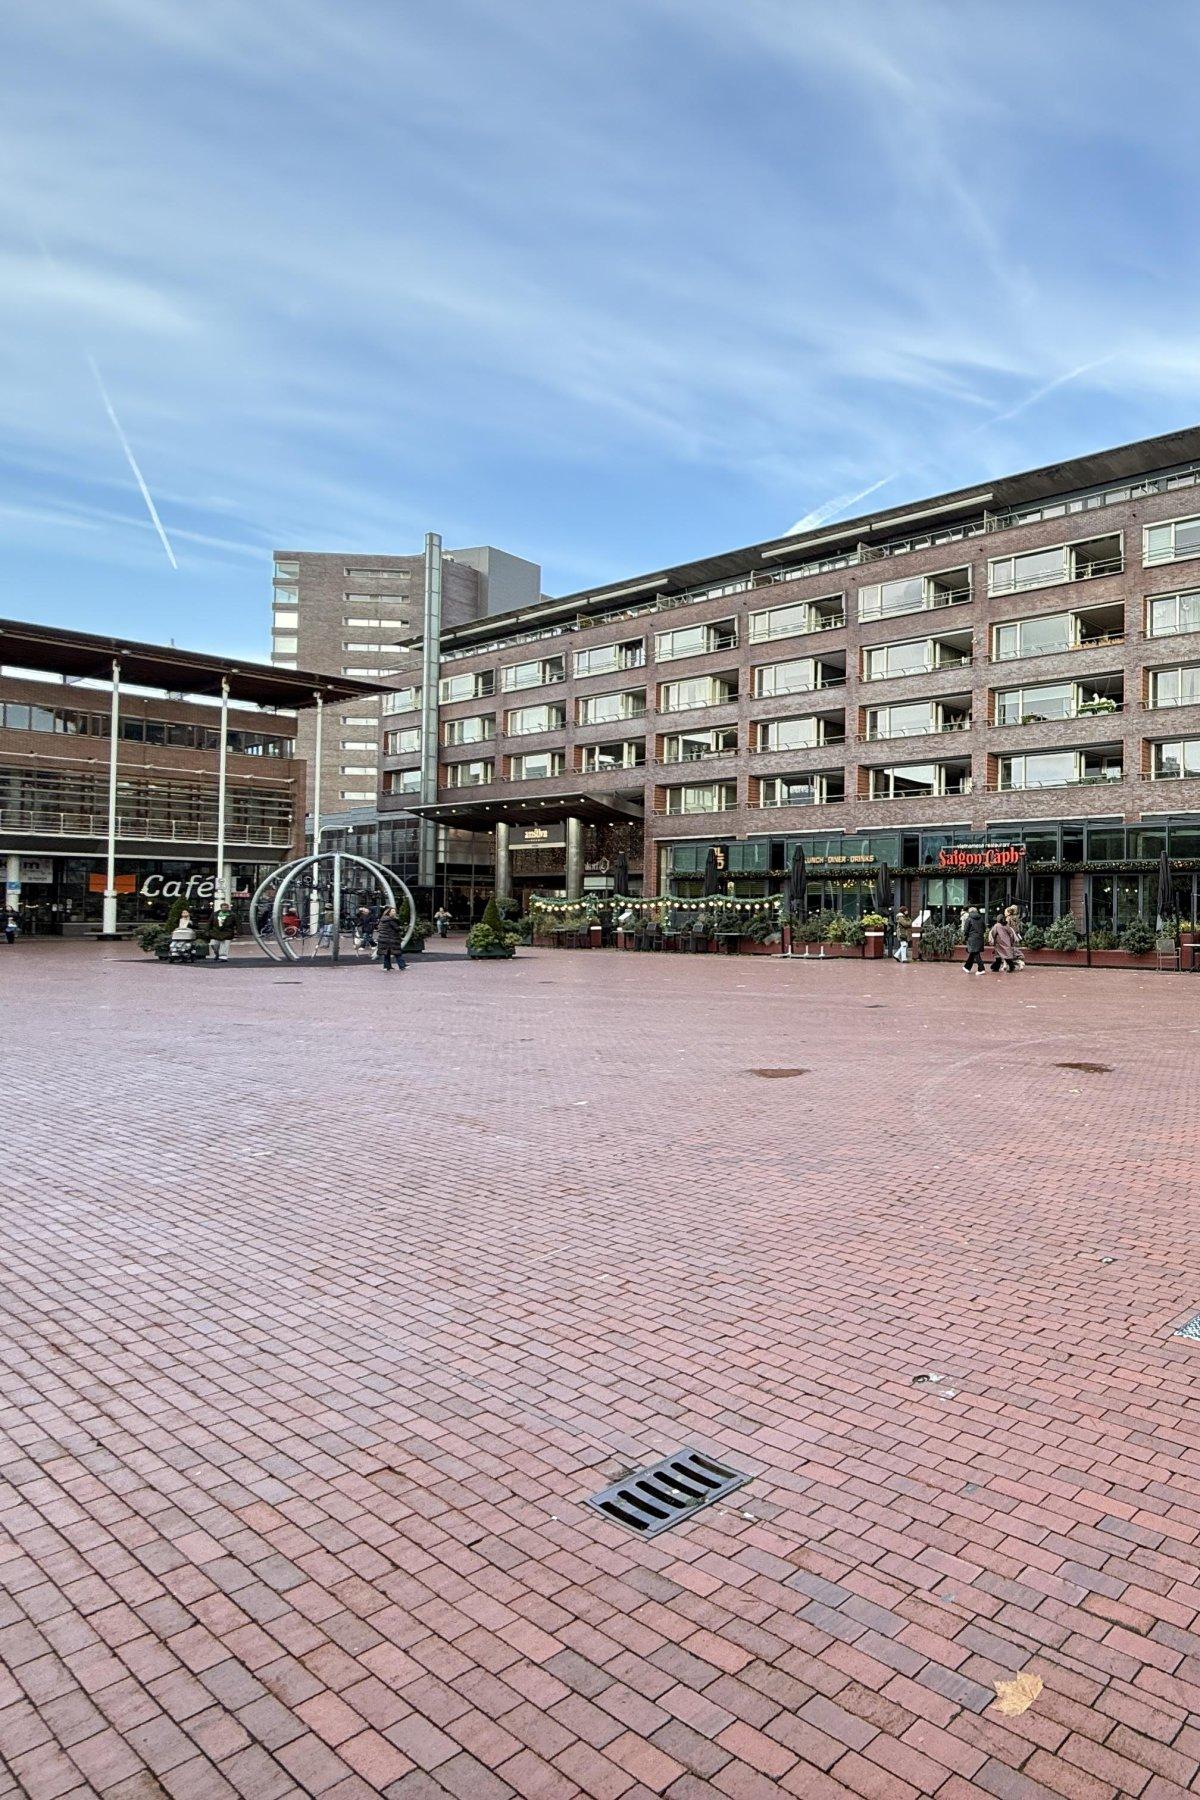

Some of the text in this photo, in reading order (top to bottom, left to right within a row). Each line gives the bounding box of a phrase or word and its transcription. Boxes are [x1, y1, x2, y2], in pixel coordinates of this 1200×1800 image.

[804, 856, 824, 864] LUNCH
[850, 855, 875, 863] DRINKS
[939, 849, 982, 868] Saigon
[141, 875, 215, 900] Café
